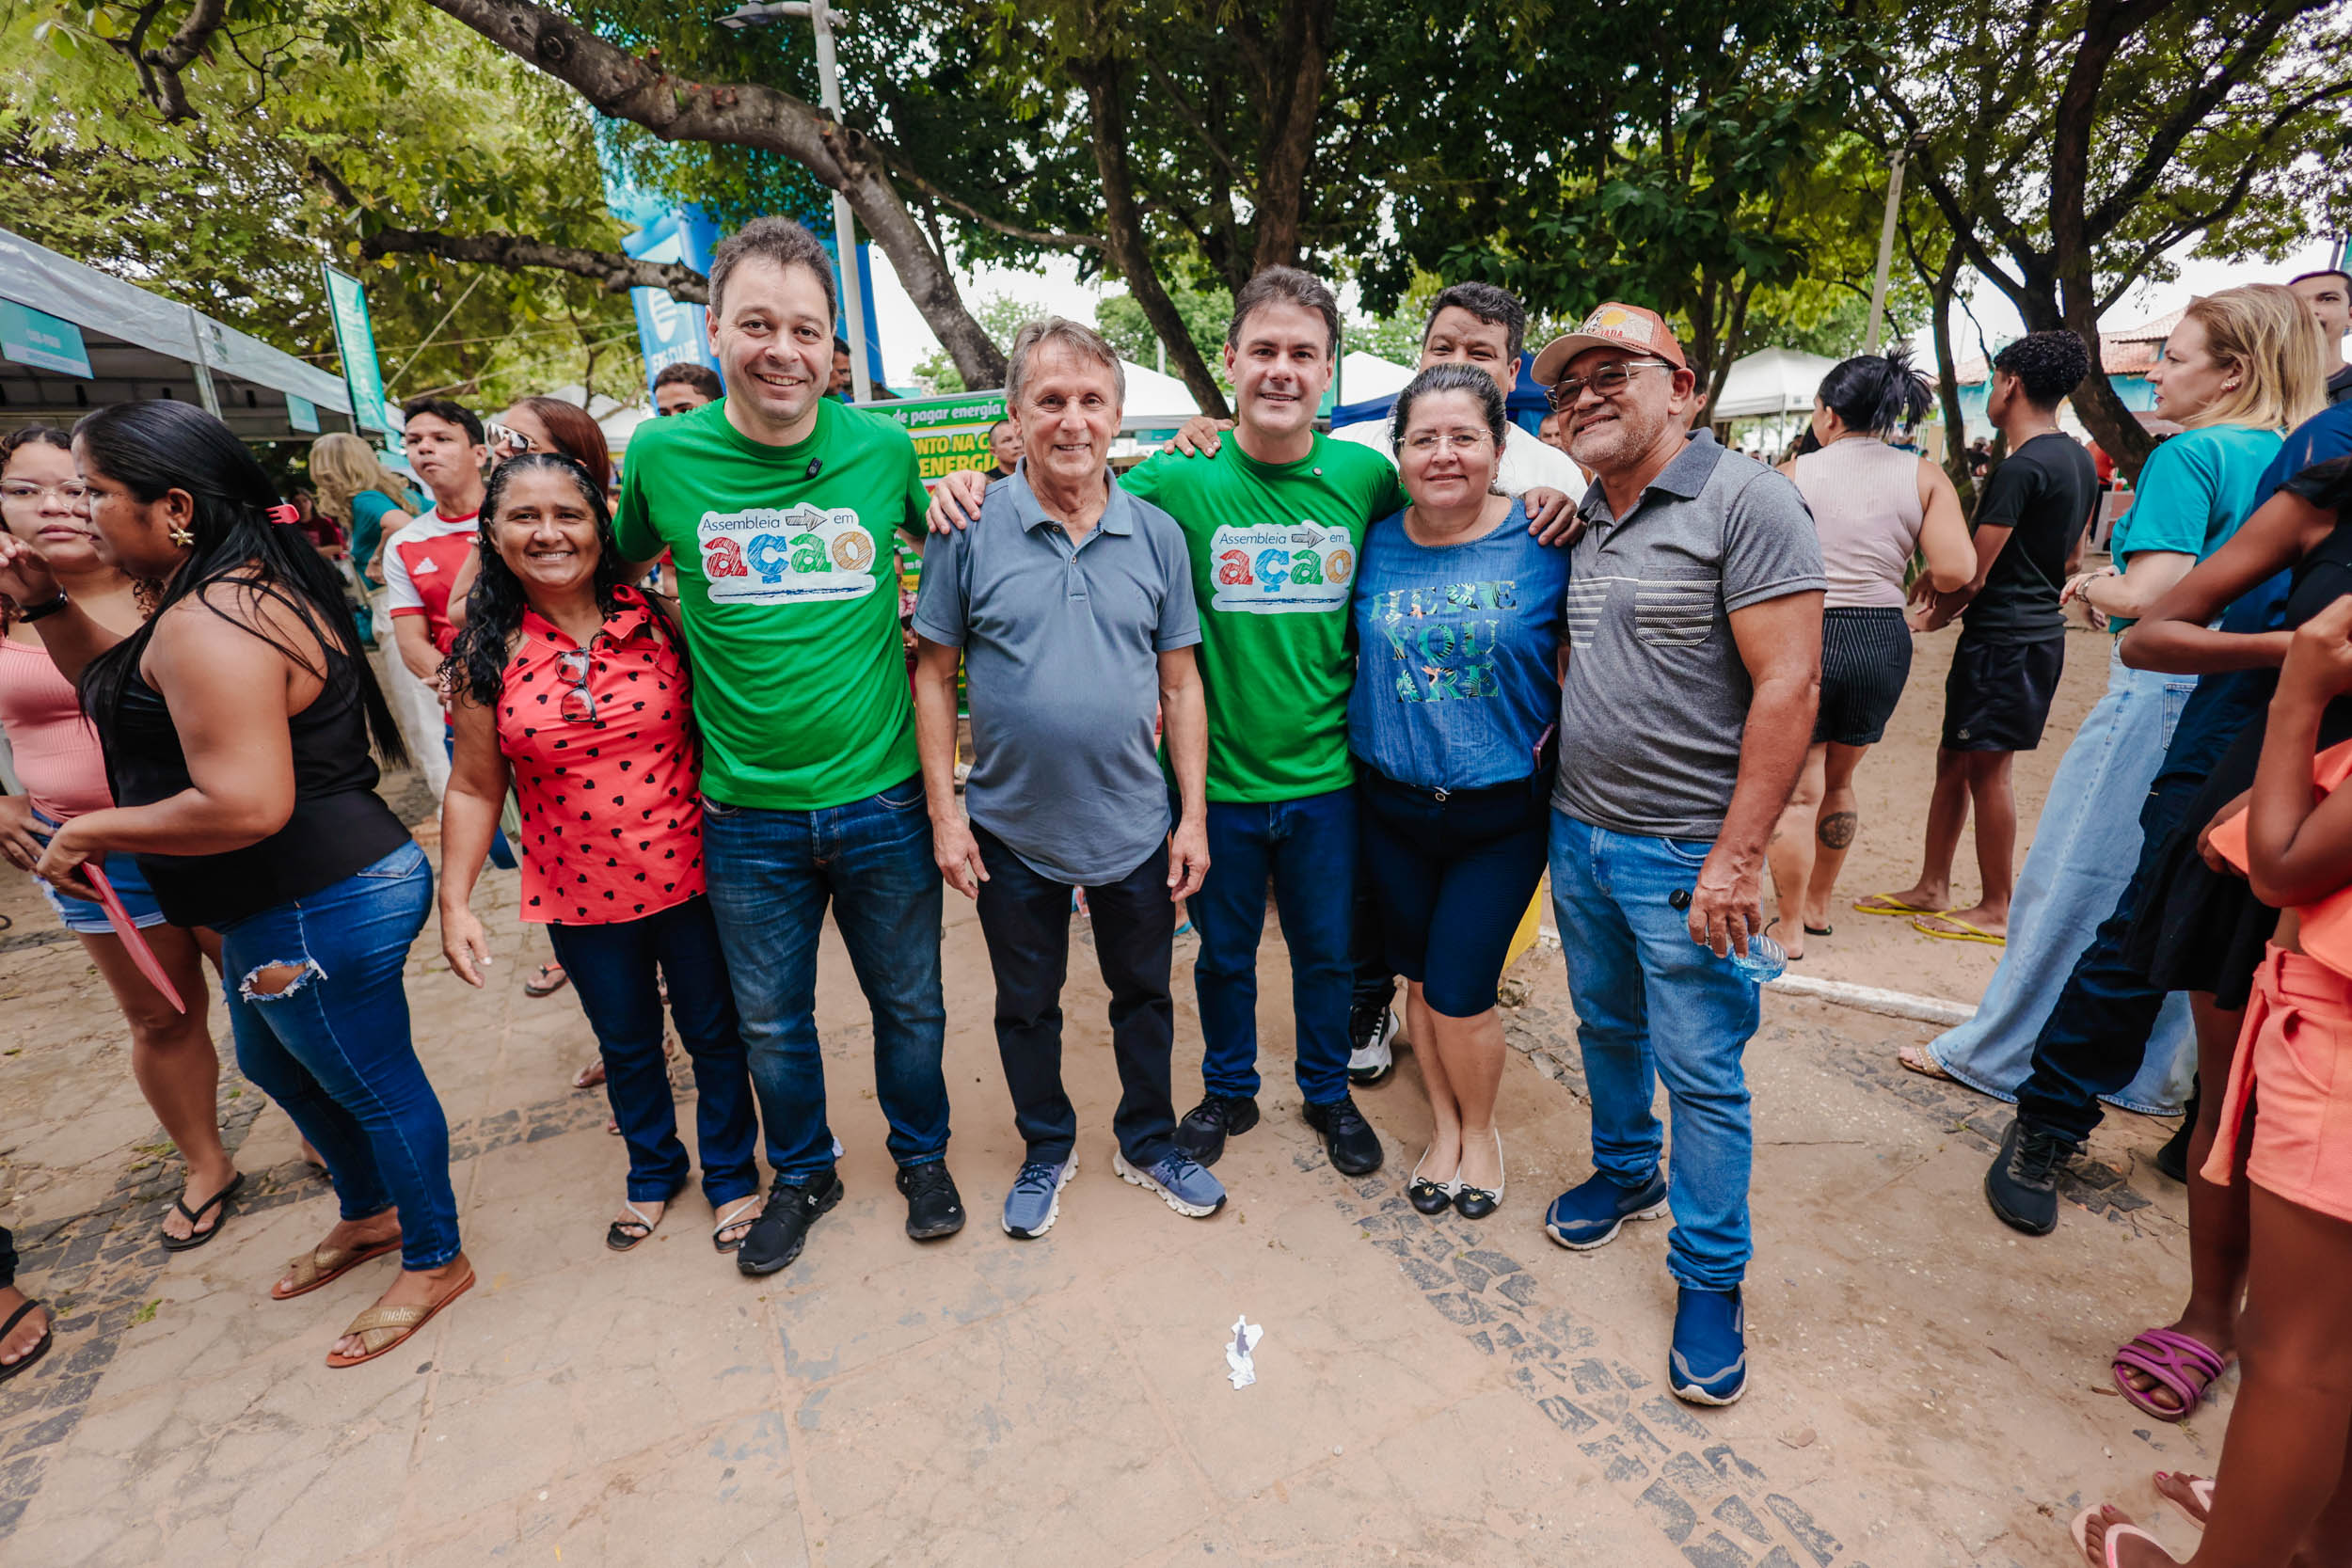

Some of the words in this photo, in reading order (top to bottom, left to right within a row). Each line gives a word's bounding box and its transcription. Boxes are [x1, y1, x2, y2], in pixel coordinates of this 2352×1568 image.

[911, 409, 949, 426] pagar
[951, 401, 1001, 420] energia
[952, 435, 976, 452] NA
[702, 515, 780, 531] Assembleia
[834, 514, 854, 524] em
[1219, 532, 1287, 545] Assembleia
[1329, 533, 1344, 543] em
[1369, 580, 1518, 625] HERE
[1382, 619, 1500, 664] YOU
[1396, 661, 1499, 703] ARE
